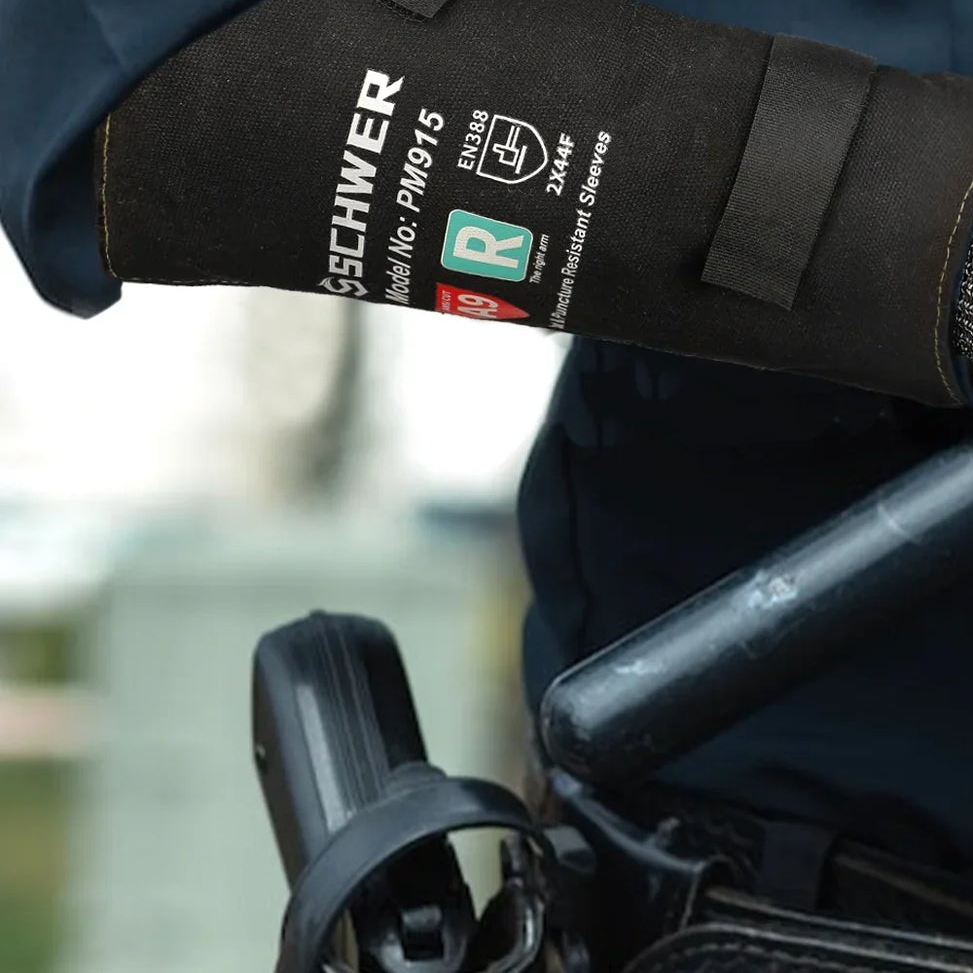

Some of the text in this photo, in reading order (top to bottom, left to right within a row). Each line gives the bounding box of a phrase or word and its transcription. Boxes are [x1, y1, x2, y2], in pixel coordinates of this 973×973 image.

[457, 109, 489, 170] EN388
[547, 132, 574, 196] 2X44F
[580, 131, 611, 207] Sleeves
[329, 69, 404, 277] SCHWER
[386, 109, 444, 305] Model No: PM915
[453, 225, 524, 269] R
[530, 234, 549, 283] The right arm
[562, 209, 592, 278] Resistant
[457, 293, 499, 317] A9
[552, 276, 574, 322] Puncture
